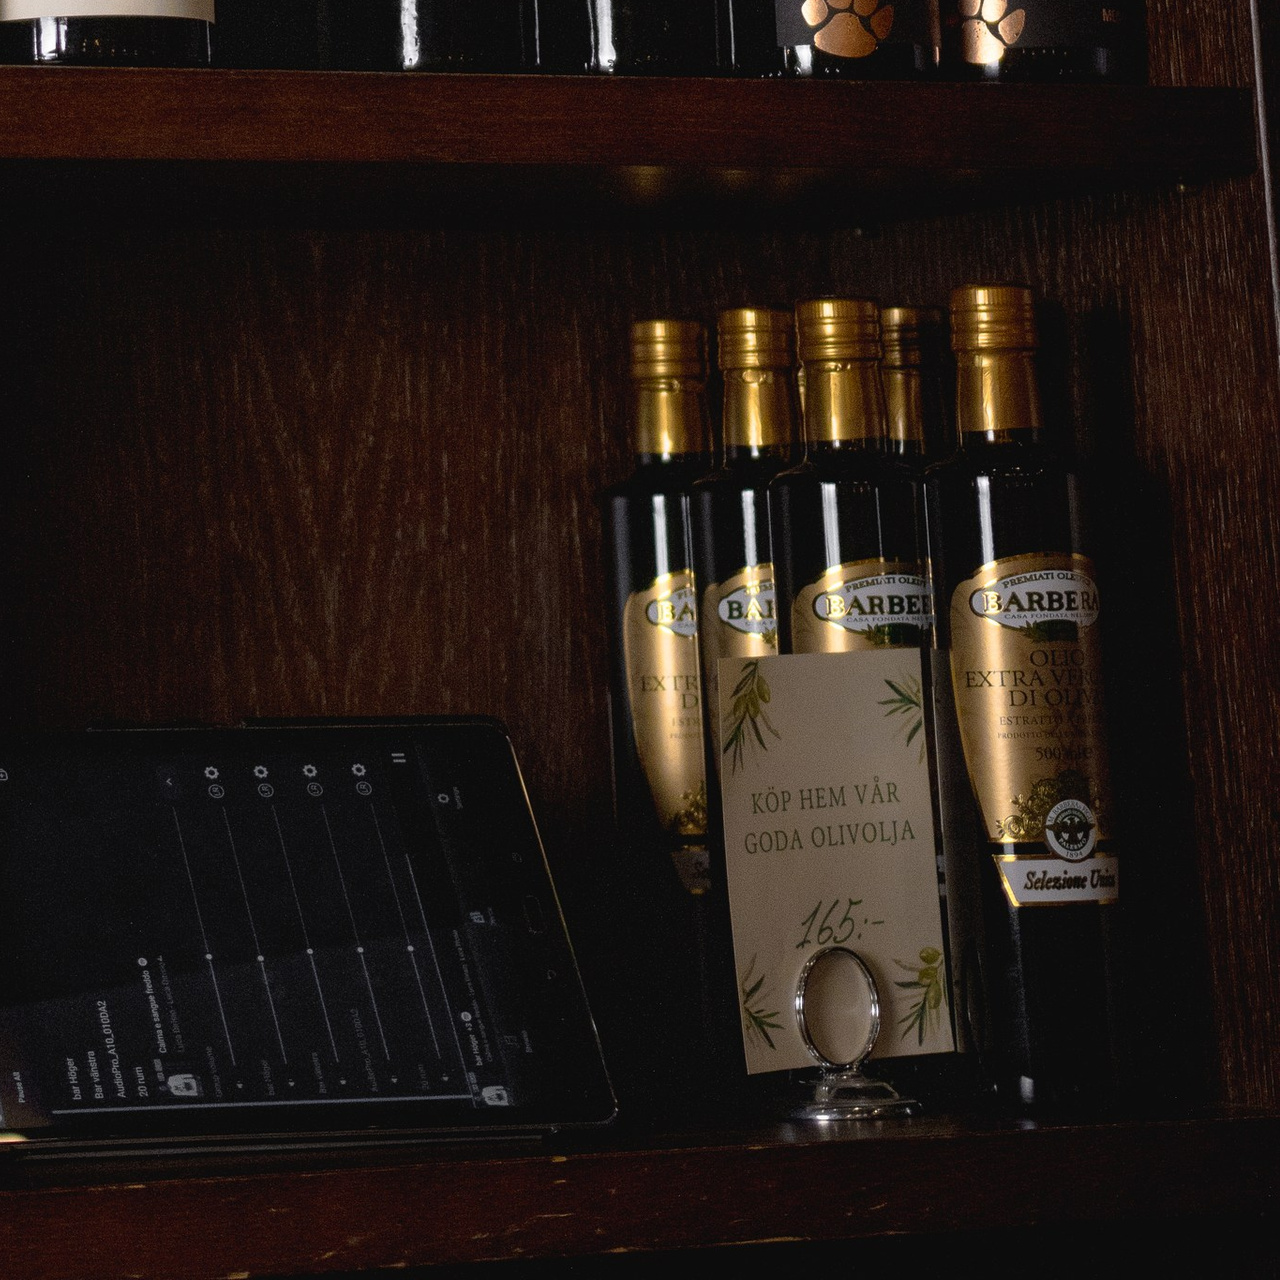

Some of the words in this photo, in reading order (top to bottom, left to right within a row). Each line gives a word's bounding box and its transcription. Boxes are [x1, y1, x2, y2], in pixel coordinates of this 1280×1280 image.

[845, 576, 896, 593] PREMIATI
[1001, 572, 1054, 589] PREMIATI
[982, 591, 1099, 615] BARBERA
[965, 669, 1045, 688] EXTRA
[1009, 689, 1036, 707] DI
[751, 786, 792, 815] KÖP
[799, 786, 847, 810] HEM
[853, 775, 900, 805] VÅR
[744, 828, 804, 855] GODA
[811, 819, 916, 848] OLIVOLJA
[1023, 869, 1088, 891] Selezione
[795, 898, 885, 949] 165:-
[96, 1000, 127, 1099] AudioPro_A10_010DA2
[65, 1056, 80, 1085] Höger
[86, 1050, 101, 1083] vänstra
[134, 1066, 146, 1085] rum
[15, 1081, 26, 1104] Pause
[71, 1085, 83, 1101] bar
[93, 1084, 105, 1100] Bar
[137, 1085, 150, 1098] 20
